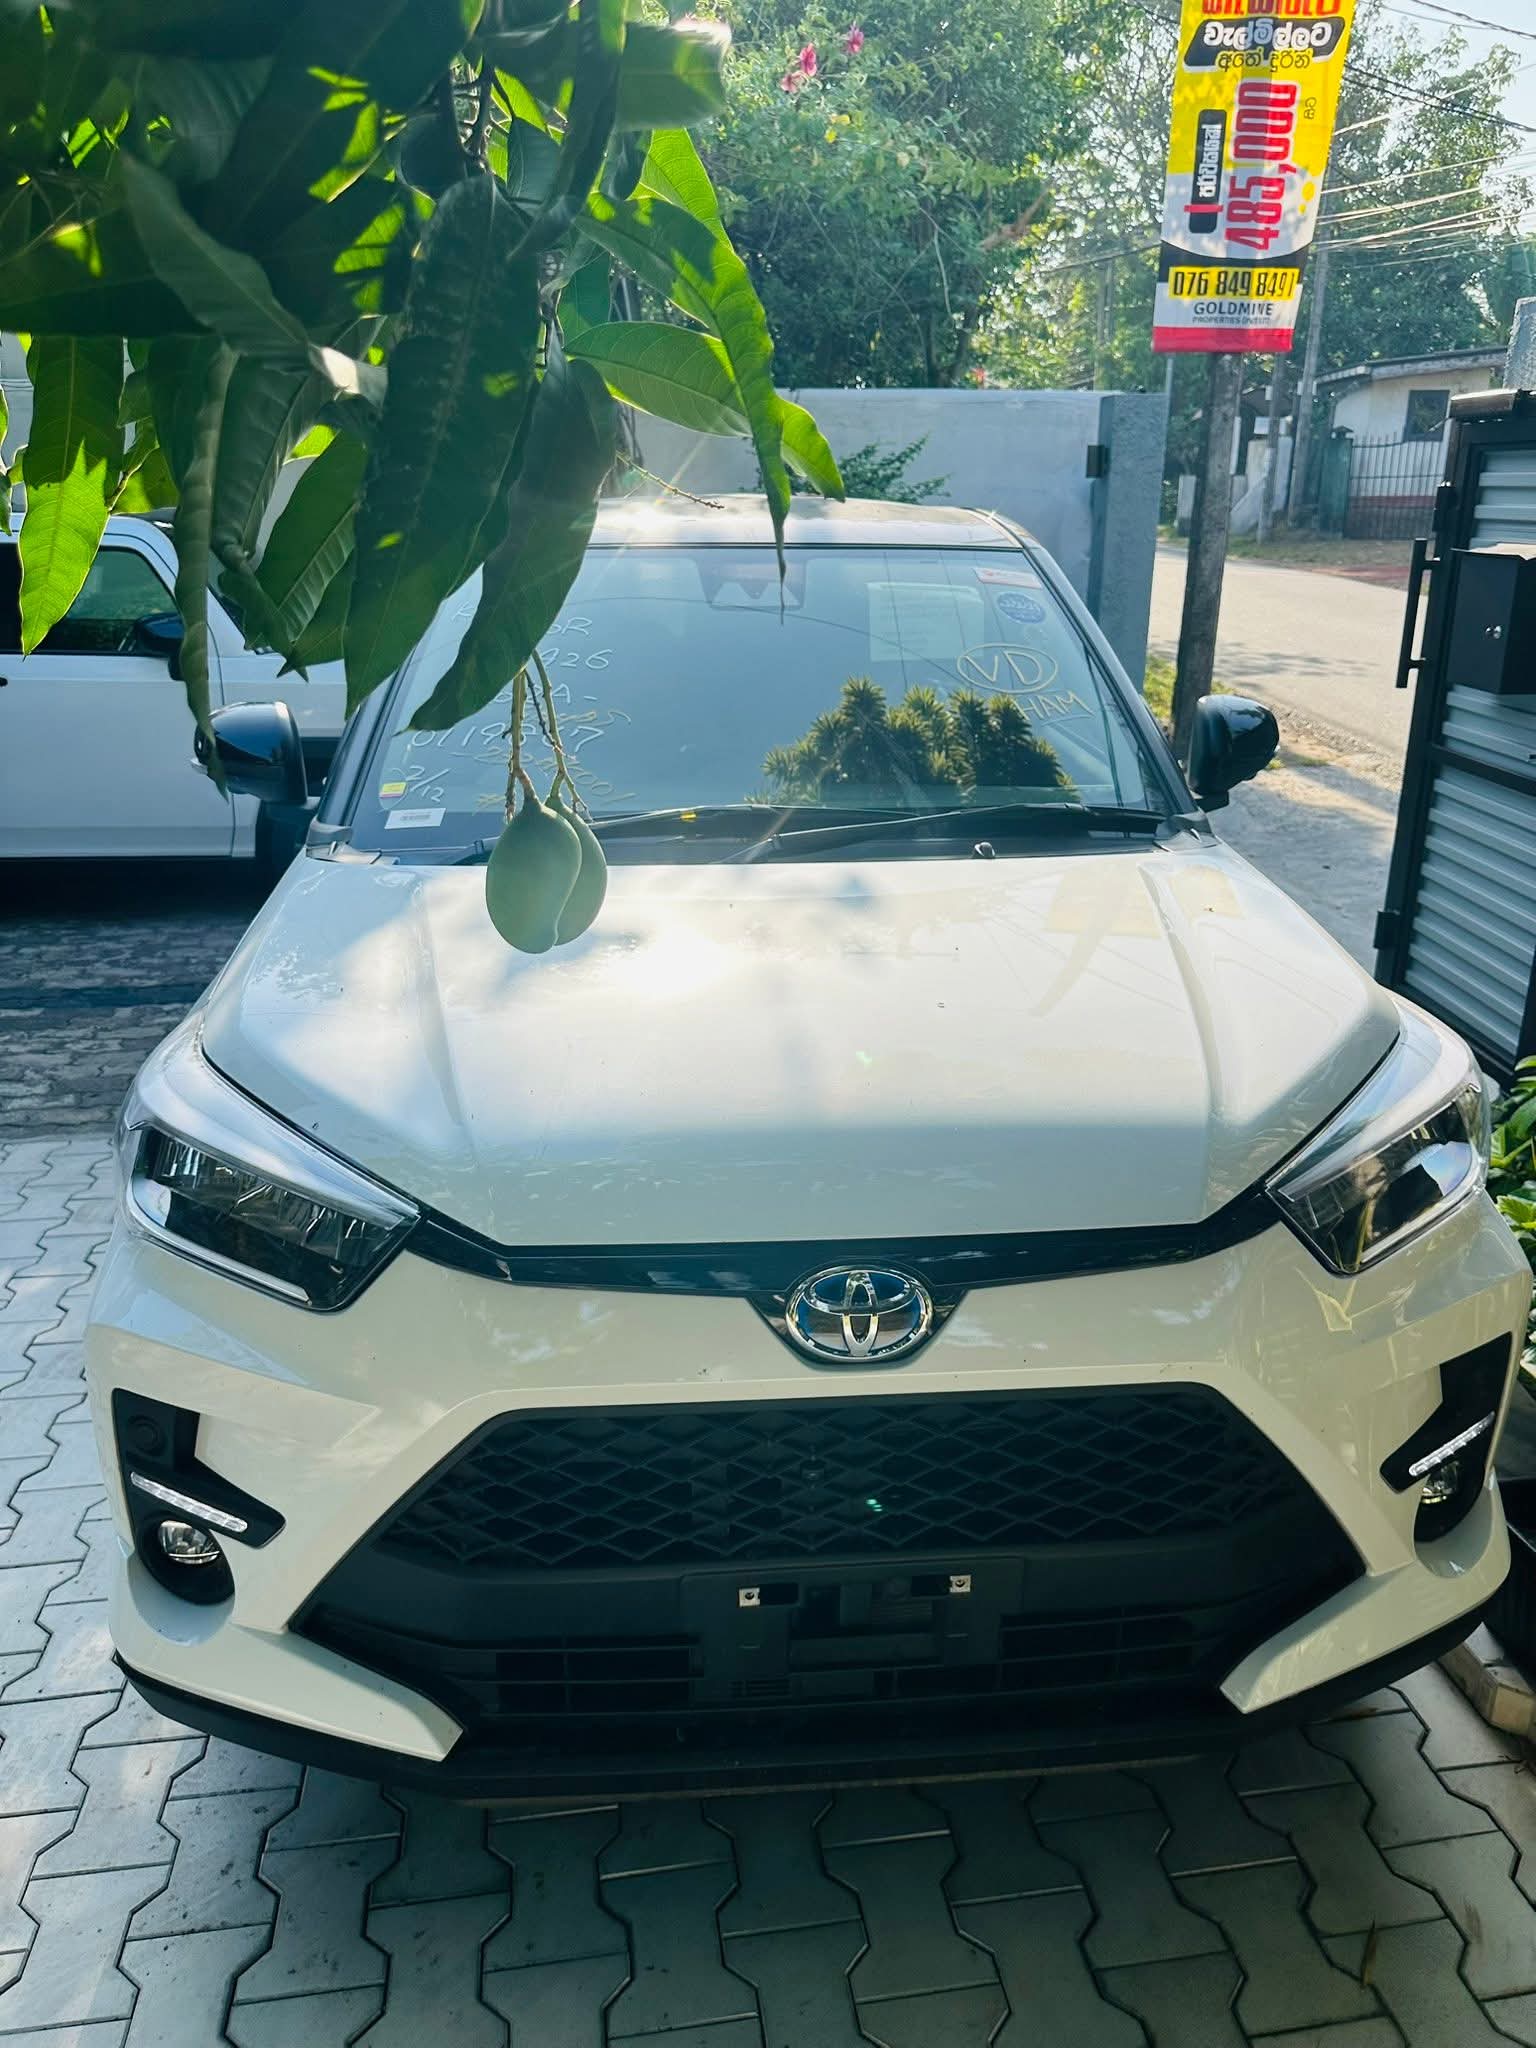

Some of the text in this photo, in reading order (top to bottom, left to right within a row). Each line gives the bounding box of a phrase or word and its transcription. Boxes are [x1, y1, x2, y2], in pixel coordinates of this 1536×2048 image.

[1224, 81, 1297, 251] 485,000
[1173, 270, 1296, 298] 076 849 8491
[1193, 301, 1274, 316] GOLDMINE
[965, 651, 1043, 685] VD
